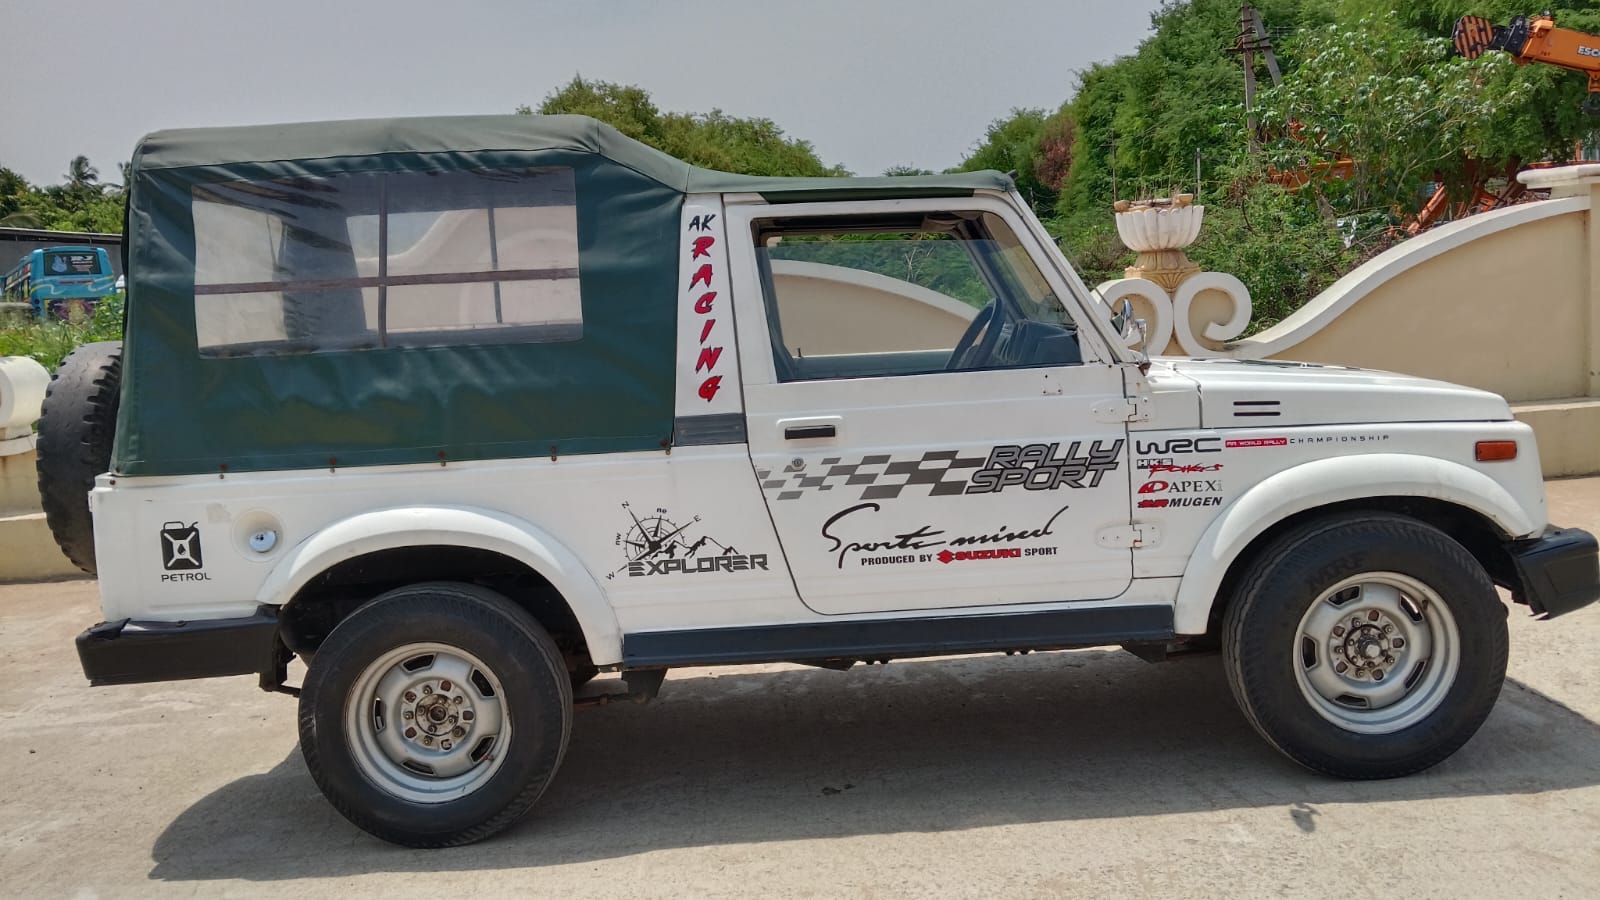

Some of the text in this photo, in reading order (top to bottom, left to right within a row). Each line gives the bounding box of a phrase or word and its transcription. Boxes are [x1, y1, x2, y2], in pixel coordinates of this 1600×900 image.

[688, 214, 716, 232] AK
[688, 236, 723, 402] RACING
[985, 438, 1125, 470] RALLY
[1136, 437, 1222, 455] WRC
[1263, 438, 1286, 446] RALLY
[1289, 434, 1389, 444] CHAMPIONSHIP
[965, 461, 1119, 494] SPORT
[1169, 496, 1223, 508] MUGEN
[949, 505, 1069, 546] mind
[628, 554, 769, 577] EXPLORER
[861, 547, 1058, 566] PRODUCED BY SUZUKI SPORT
[161, 572, 211, 582] PETROL
